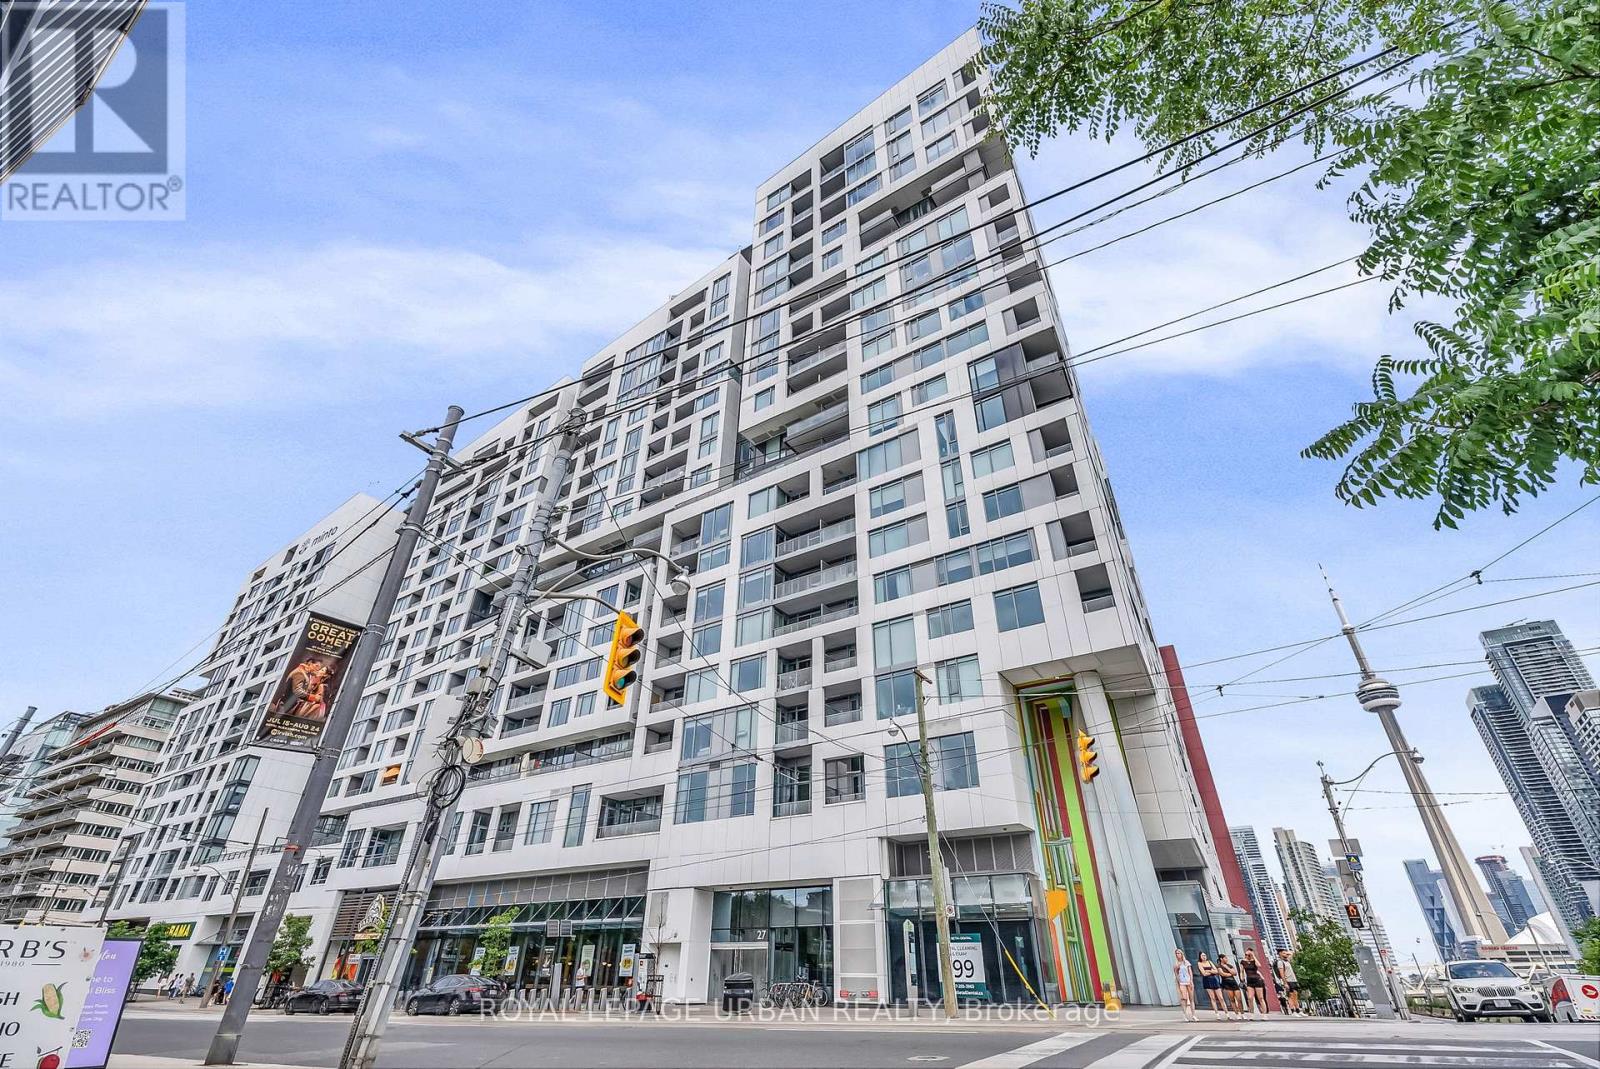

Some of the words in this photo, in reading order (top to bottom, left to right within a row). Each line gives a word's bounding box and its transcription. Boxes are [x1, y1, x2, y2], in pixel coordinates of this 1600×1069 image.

[308, 631, 352, 649] COMET
[310, 622, 354, 641] GREAT
[757, 930, 766, 940] 27
[952, 959, 975, 978] 99
